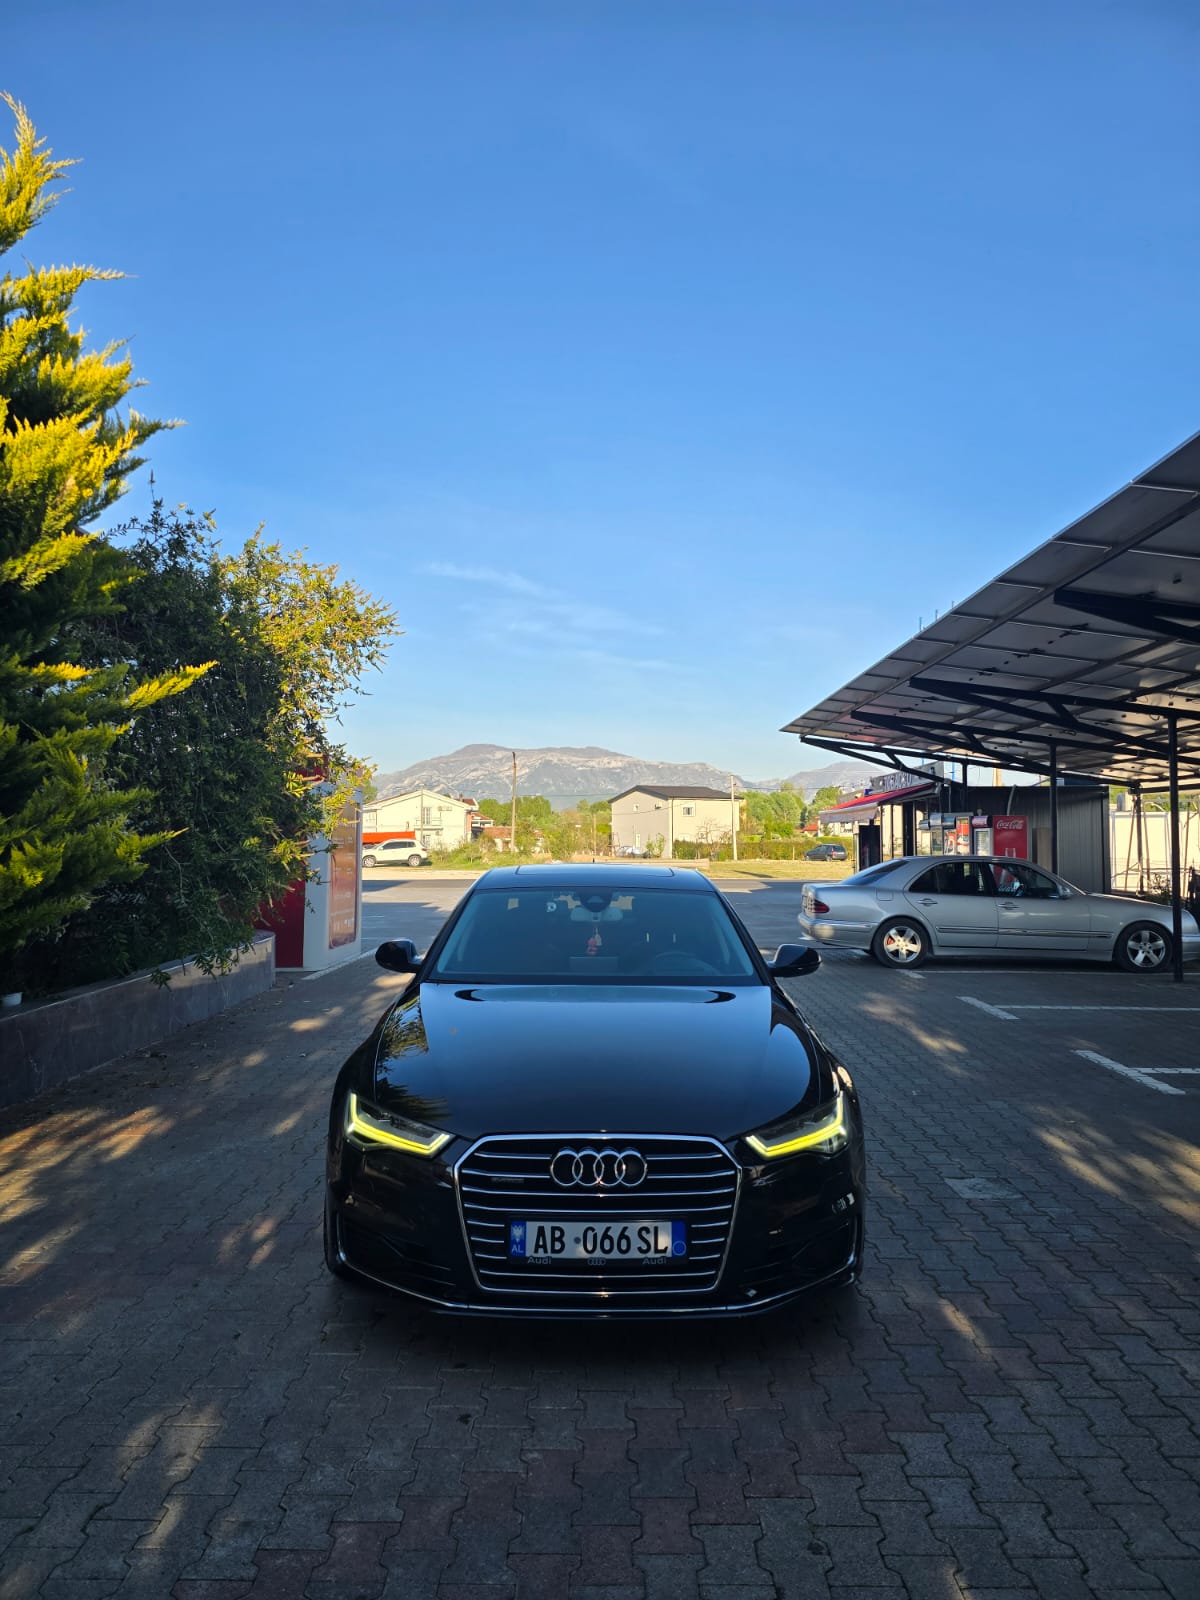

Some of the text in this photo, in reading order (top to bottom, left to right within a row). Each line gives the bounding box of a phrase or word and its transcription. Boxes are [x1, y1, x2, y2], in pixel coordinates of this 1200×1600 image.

[533, 1225, 668, 1255] AB 066 SL
[511, 1244, 523, 1254] AL
[527, 1256, 552, 1265] Audi
[642, 1256, 667, 1265] Audi
